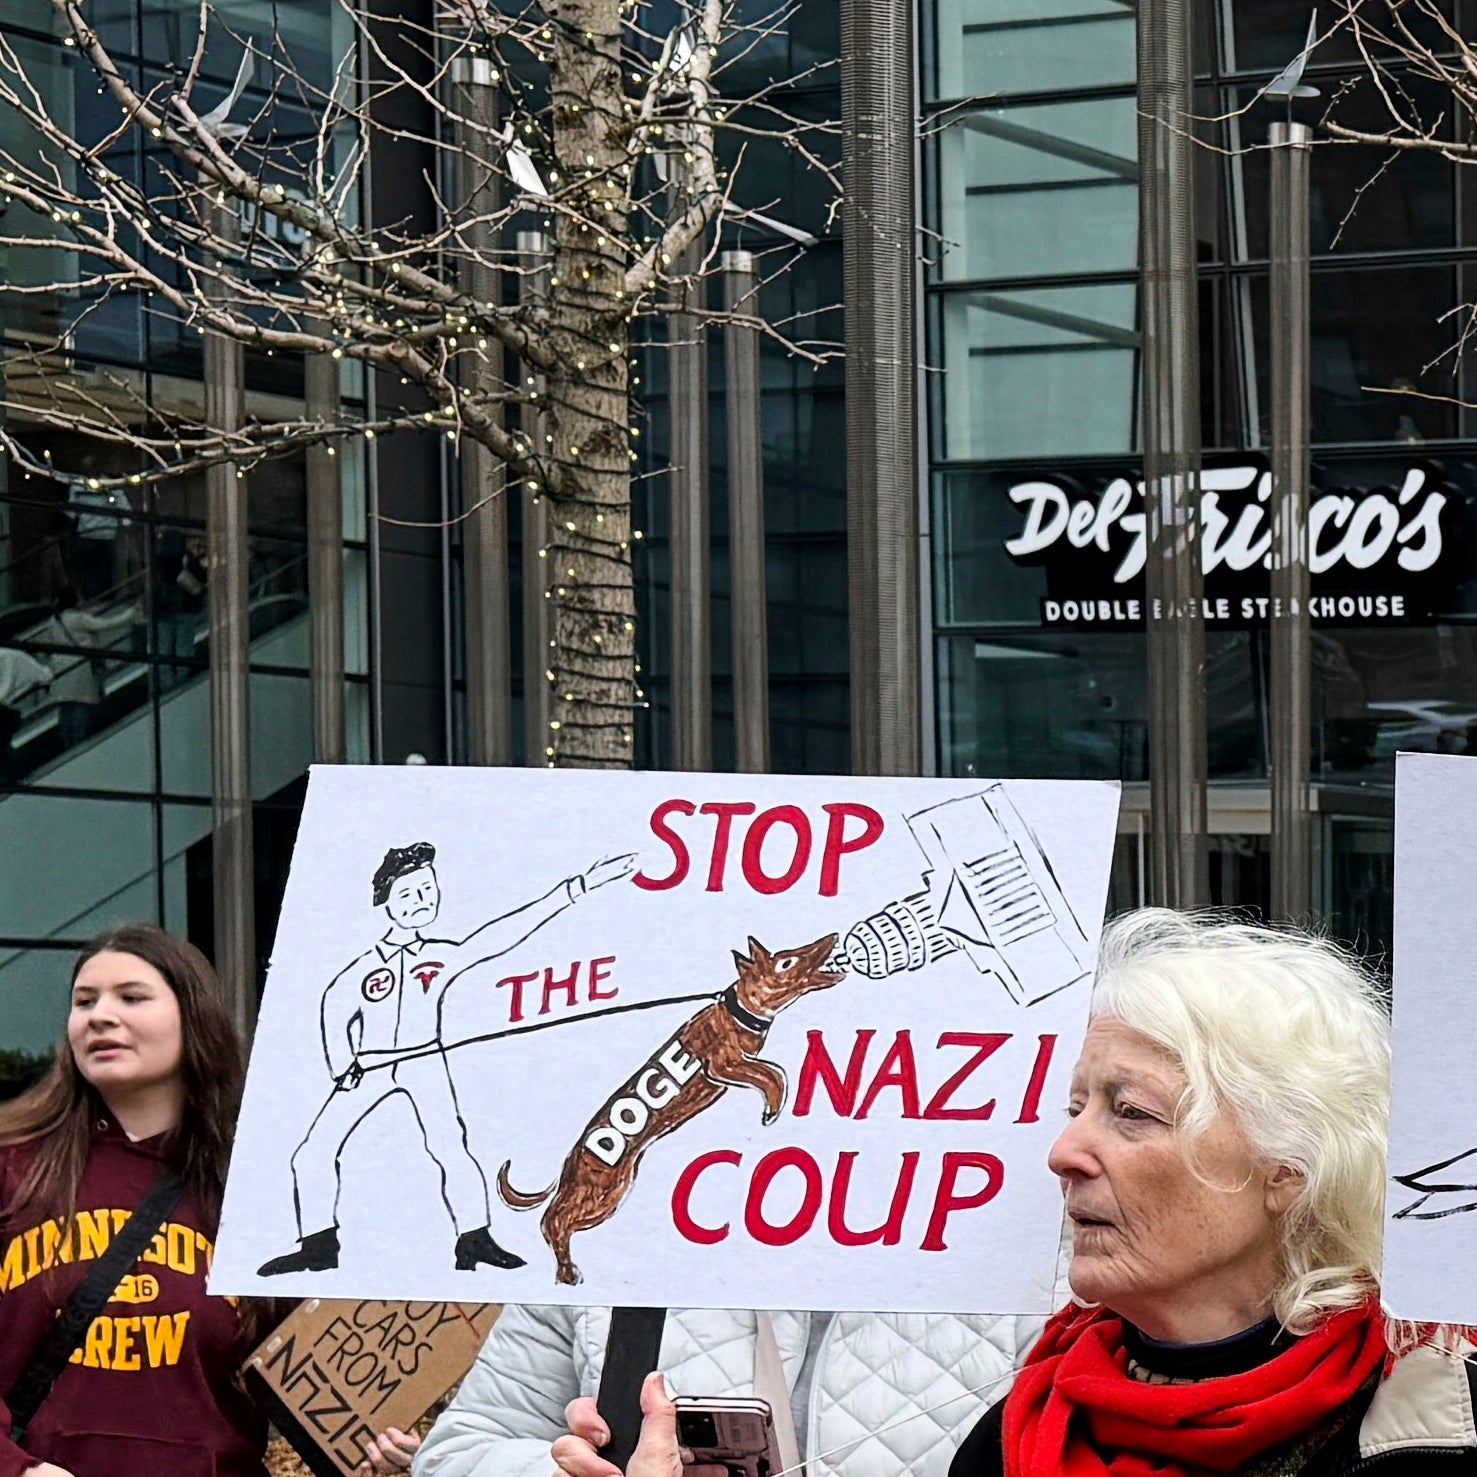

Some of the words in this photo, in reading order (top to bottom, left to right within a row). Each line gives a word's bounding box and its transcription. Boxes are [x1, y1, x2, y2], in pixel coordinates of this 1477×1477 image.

[1005, 477, 1132, 557] Del
[1044, 599, 1141, 621] DOUBLE
[633, 799, 885, 898] STOP
[498, 956, 619, 1023] THE
[584, 1038, 702, 1168] DOGE
[792, 1029, 1057, 1125] NAZI
[672, 1146, 1005, 1252] COUP
[0, 1208, 215, 1296] MINNSOT
[64, 1310, 190, 1371] REW
[352, 1300, 433, 1376] CARS
[404, 1300, 462, 1338] UY
[266, 1334, 378, 1471] NAZIS
[313, 1316, 402, 1416] FROM
